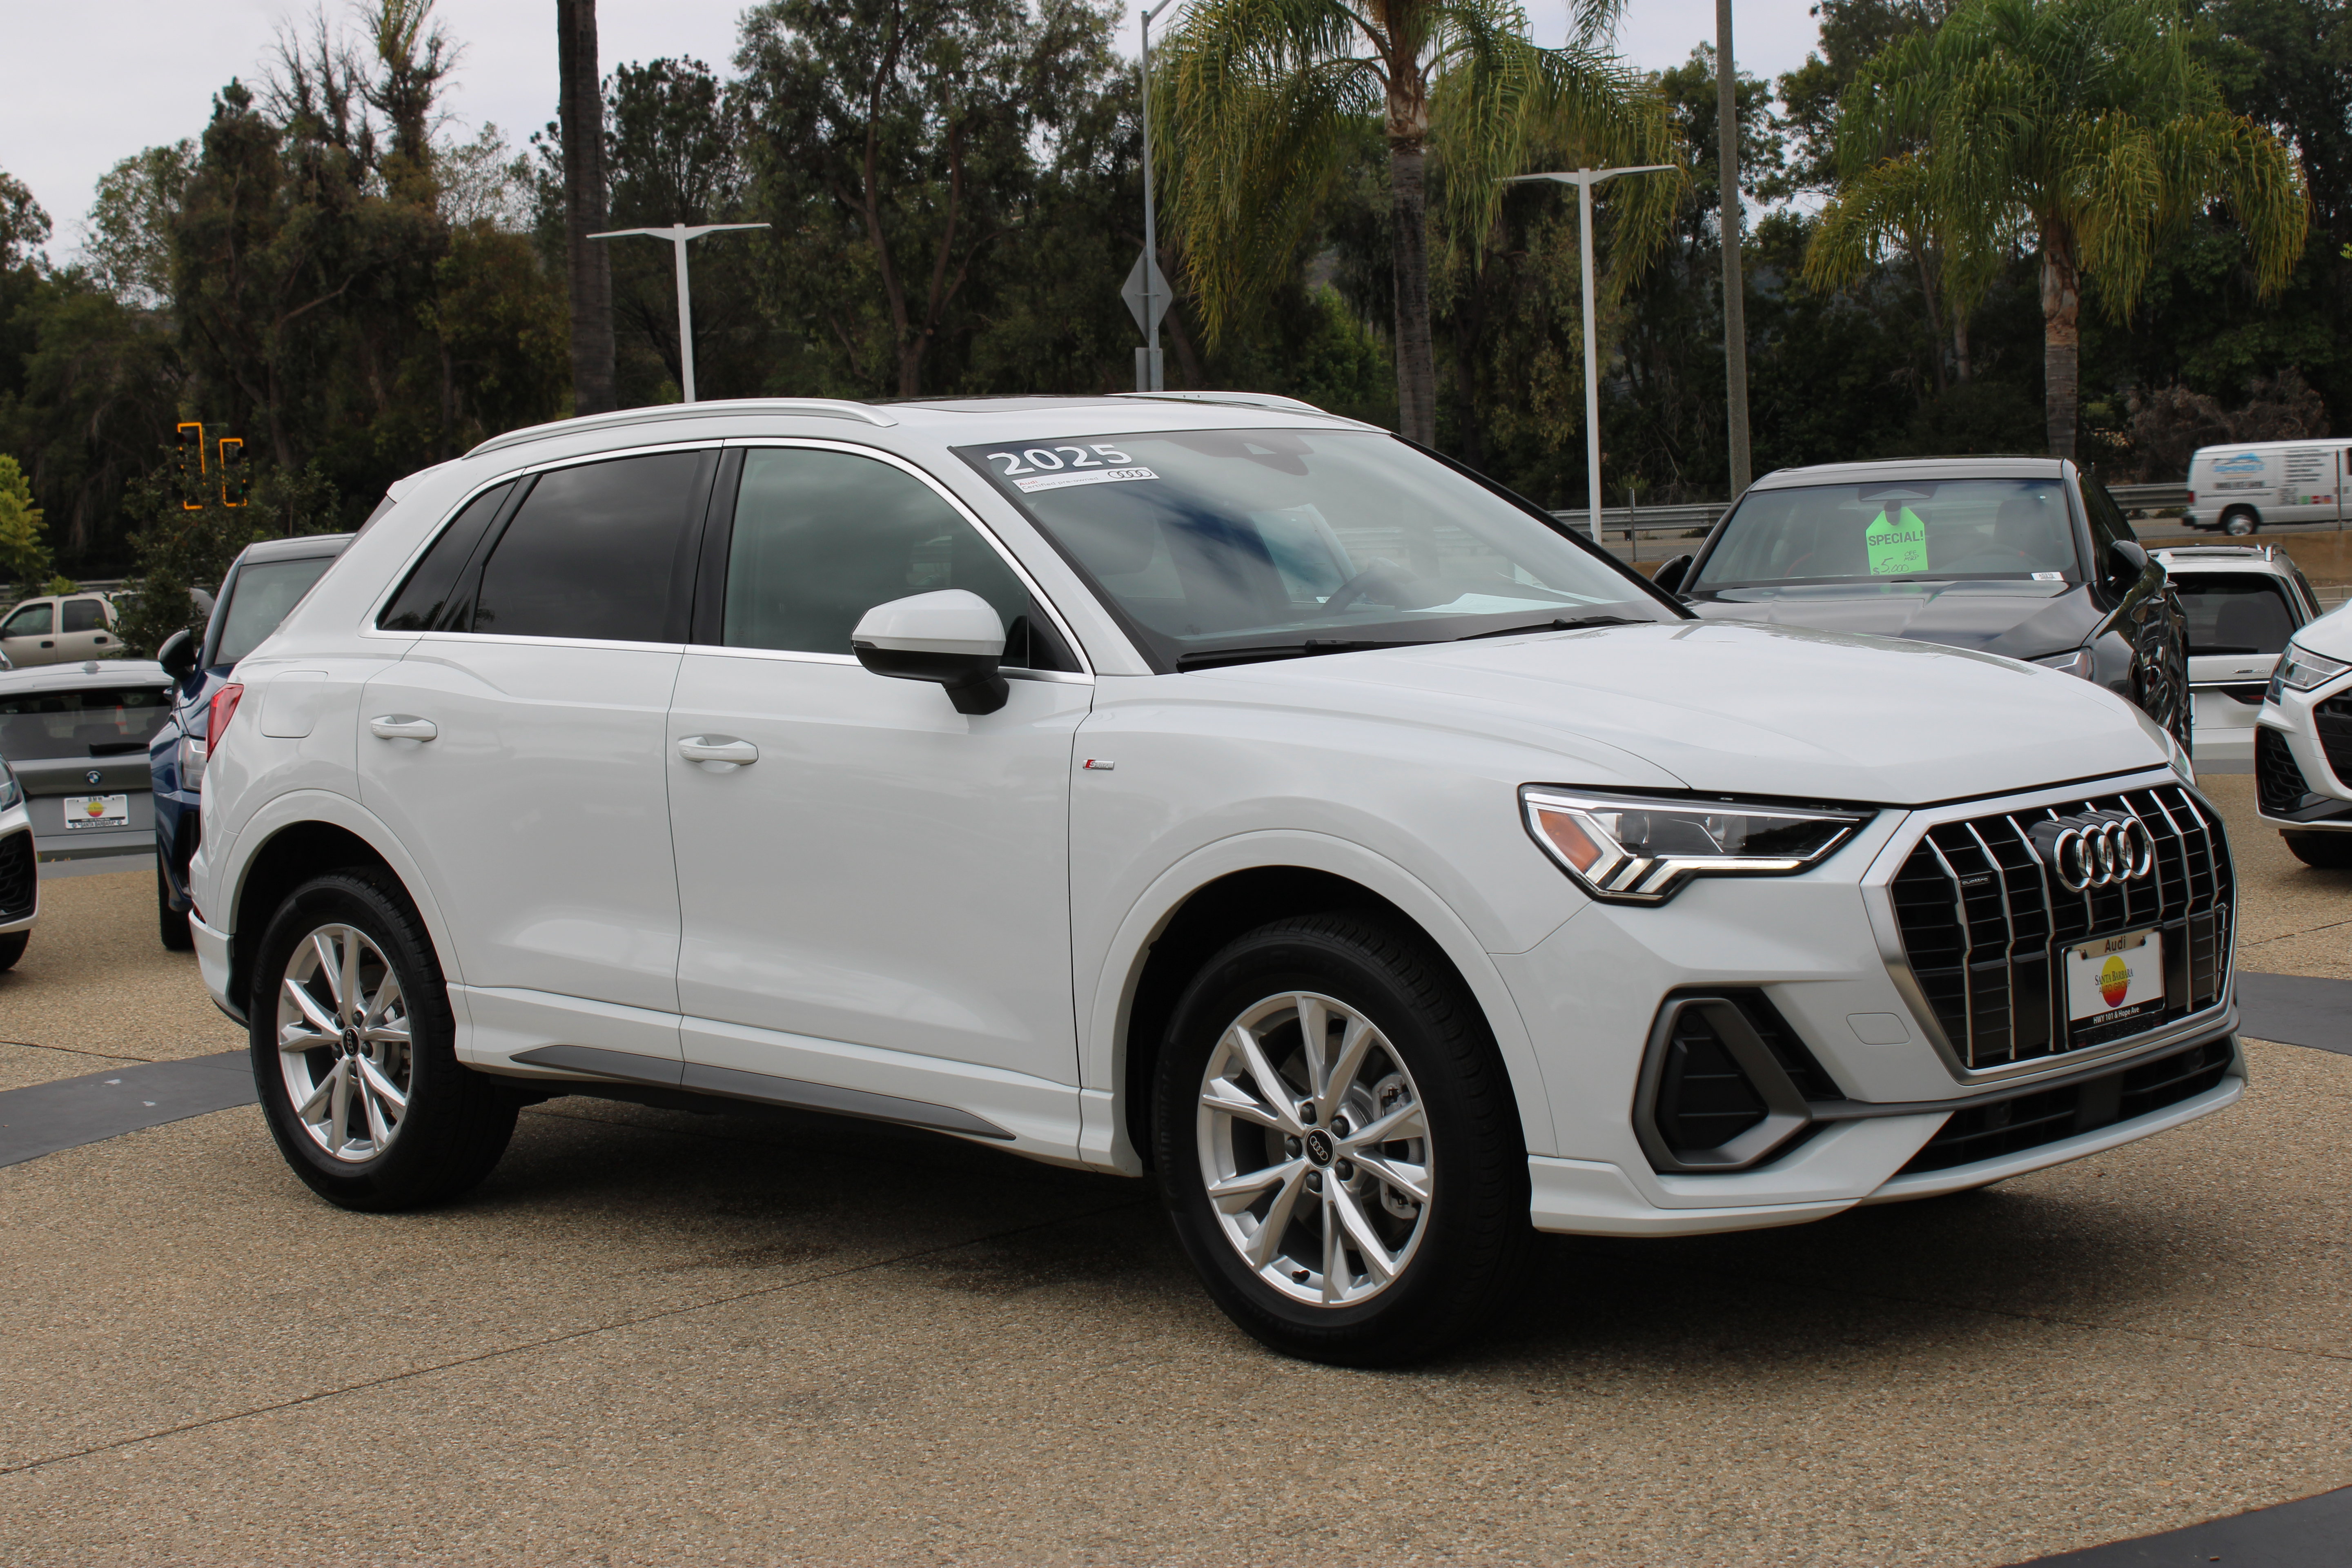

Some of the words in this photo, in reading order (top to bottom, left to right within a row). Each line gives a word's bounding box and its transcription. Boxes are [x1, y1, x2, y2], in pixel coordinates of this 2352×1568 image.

[987, 444, 1132, 476] 2025
[1022, 481, 1056, 490] Certified
[1058, 477, 1099, 486] pre-owned
[1868, 530, 1924, 546] SPECIAL!
[2105, 935, 2126, 953] Audi
[2098, 984, 2112, 994] AUTO
[2114, 979, 2131, 991] GROUP
[2093, 1014, 2105, 1024] HWY
[2118, 1009, 2131, 1017] Hope
